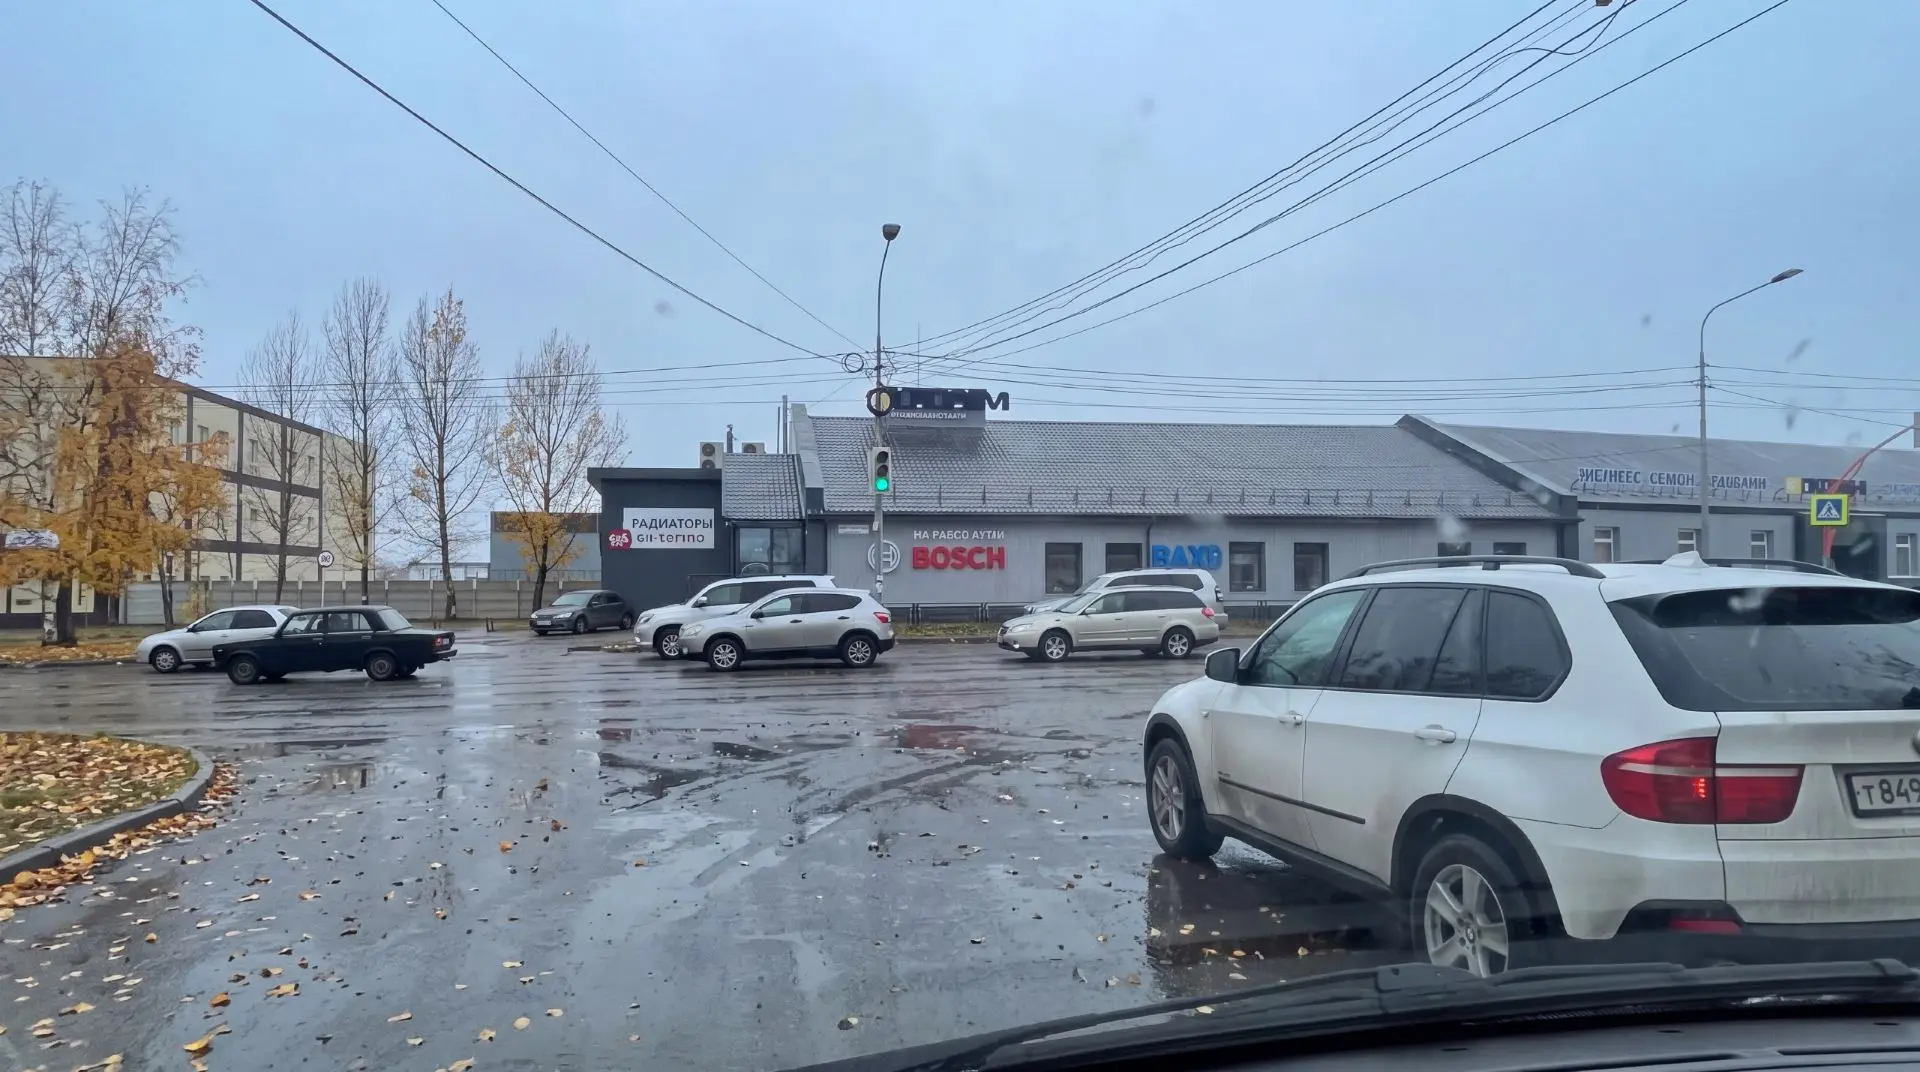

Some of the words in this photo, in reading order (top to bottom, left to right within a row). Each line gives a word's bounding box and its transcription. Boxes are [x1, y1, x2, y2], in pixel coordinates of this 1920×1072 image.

[632, 518, 713, 530] РАДИАТОРЫ
[913, 530, 929, 540] НА
[912, 546, 1006, 570] BOSCH
